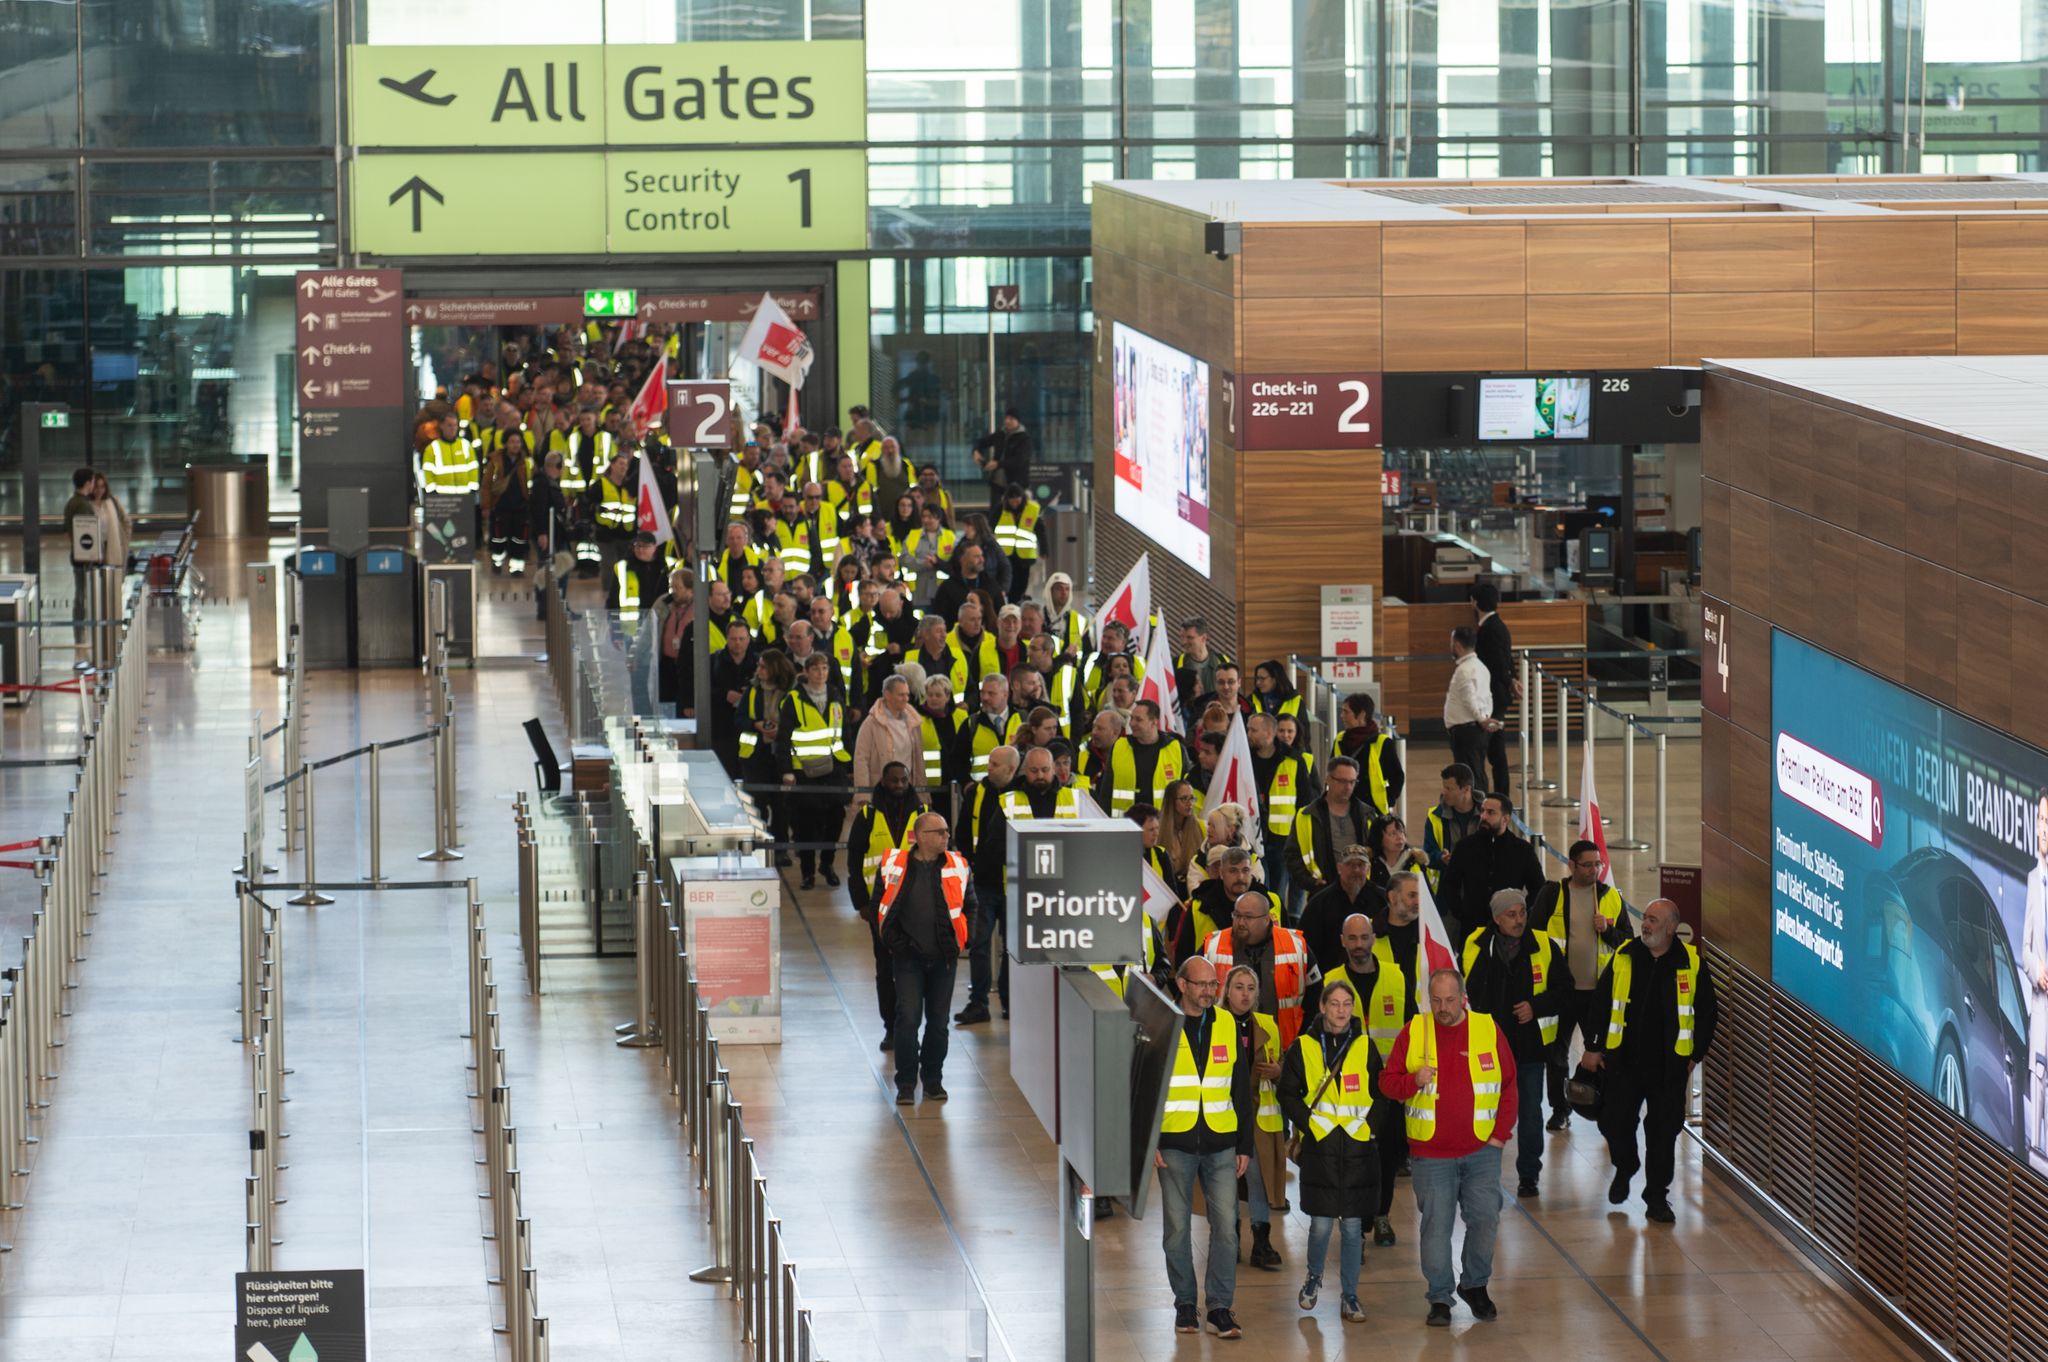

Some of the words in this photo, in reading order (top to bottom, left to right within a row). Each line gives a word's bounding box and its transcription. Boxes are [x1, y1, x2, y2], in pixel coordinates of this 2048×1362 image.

[491, 62, 586, 122] All
[624, 65, 815, 121] Gates
[624, 168, 740, 198] Security
[787, 168, 813, 228] 1
[625, 207, 730, 231] Control
[321, 276, 344, 287] Alle
[346, 276, 378, 287] Gates
[322, 289, 333, 298] All
[335, 289, 360, 298] Gates
[439, 302, 530, 312] Sicherheitskontrolle
[659, 299, 699, 310] Check-in
[323, 343, 372, 355] Check-in
[1602, 378, 1630, 392] 226
[695, 393, 726, 444] 2
[1252, 381, 1318, 396] Check-in
[1338, 380, 1370, 433] 2
[1718, 614, 1729, 693] 4
[1781, 747, 1811, 792] Premium
[1812, 764, 1836, 804] Parken
[1837, 784, 1848, 812] am
[1849, 785, 1863, 820] BER
[1916, 746, 1960, 816] BERLIN
[1776, 826, 1801, 864] Premium
[1802, 841, 1814, 872] Plus
[689, 891, 715, 903] BER
[1026, 889, 1137, 923] Priority
[1776, 868, 1788, 895] und
[1788, 873, 1803, 904] Valet
[1803, 881, 1824, 917] Service
[1824, 892, 1834, 923] für
[1834, 901, 1844, 930] Sie
[1026, 924, 1094, 949] Lane
[246, 1281, 309, 1292] Flüssigkeiten
[310, 1280, 334, 1289] bitte
[246, 1293, 265, 1303] hier
[267, 1293, 320, 1304] entsorgen!
[247, 1306, 283, 1317] Dispose
[285, 1305, 296, 1314] of
[298, 1304, 330, 1316] liquids
[273, 1317, 307, 1329] please!
